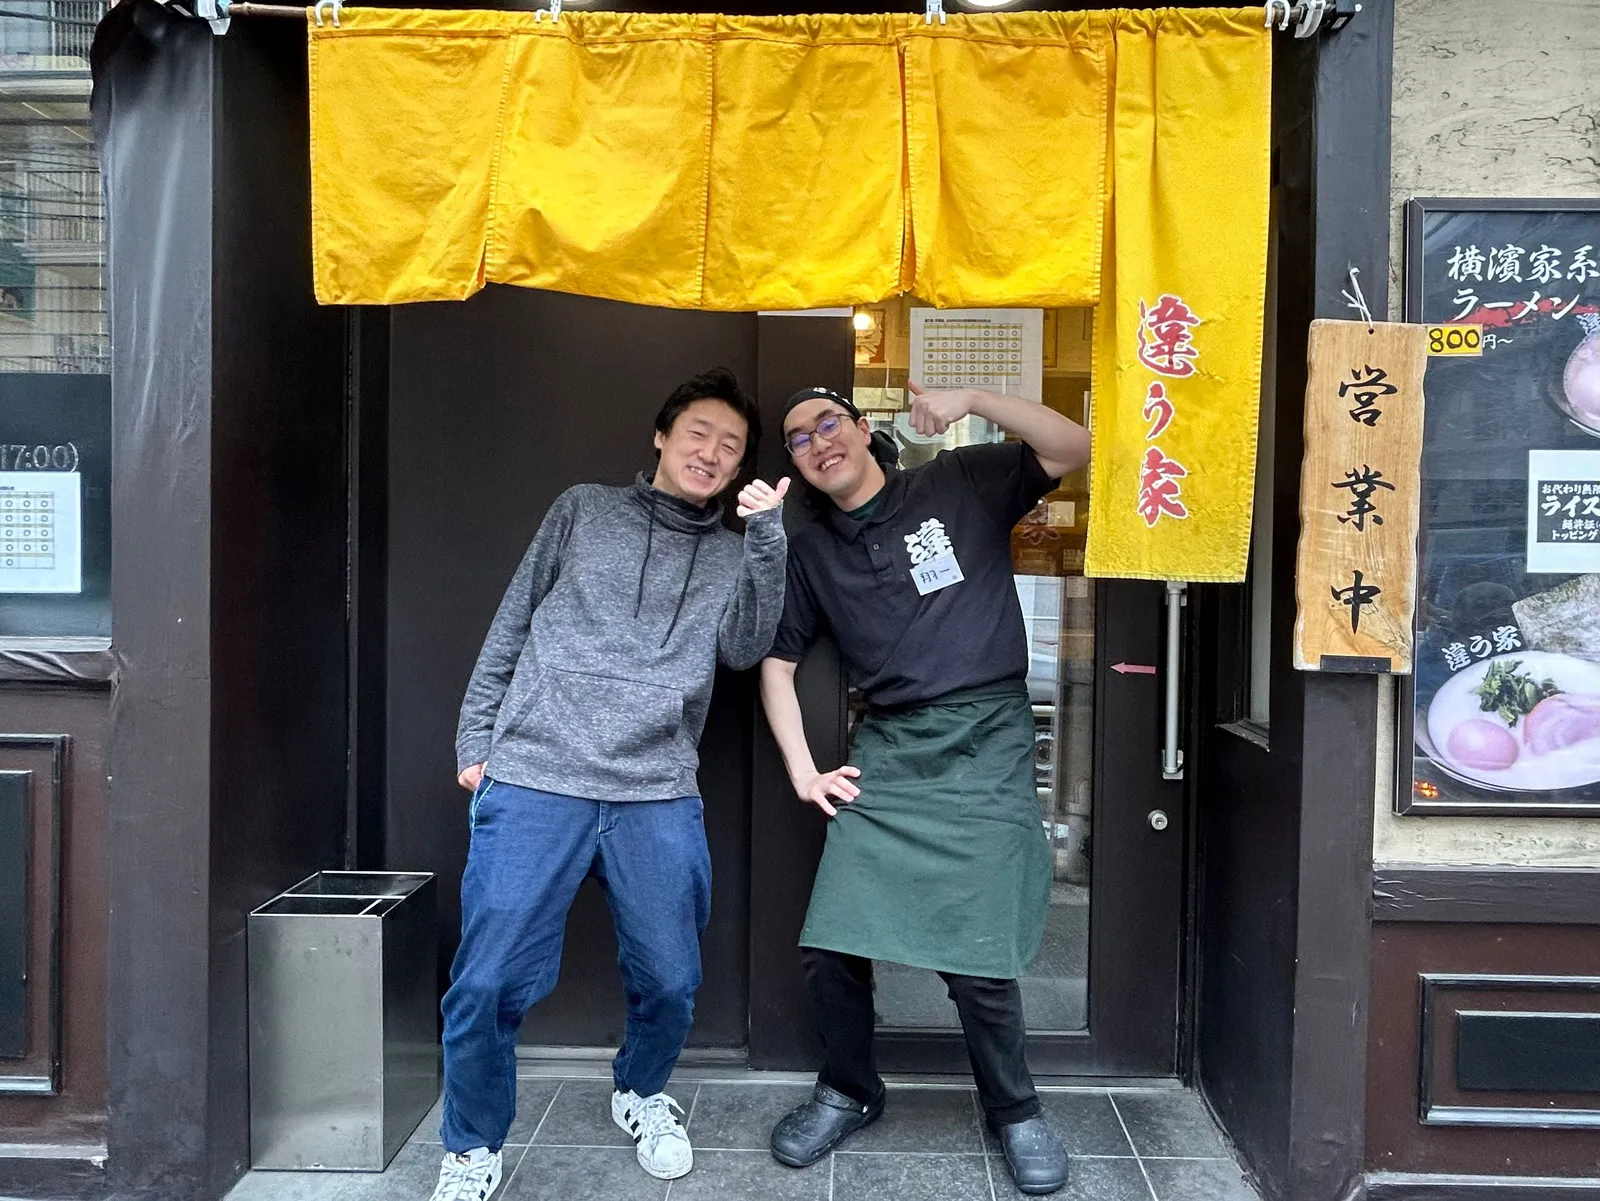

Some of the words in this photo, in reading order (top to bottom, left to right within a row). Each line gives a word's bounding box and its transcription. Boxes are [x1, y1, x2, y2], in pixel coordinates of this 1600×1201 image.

[1447, 244, 1600, 283] 横濱家系
[1453, 288, 1580, 320] ラーメン
[1137, 293, 1200, 527] 違う家
[0, 441, 79, 473] 17:00)
[1330, 364, 1398, 635] 営業中
[1540, 495, 1600, 518] ライス
[1551, 529, 1599, 540] トッピング
[1441, 625, 1522, 672] 違う家
